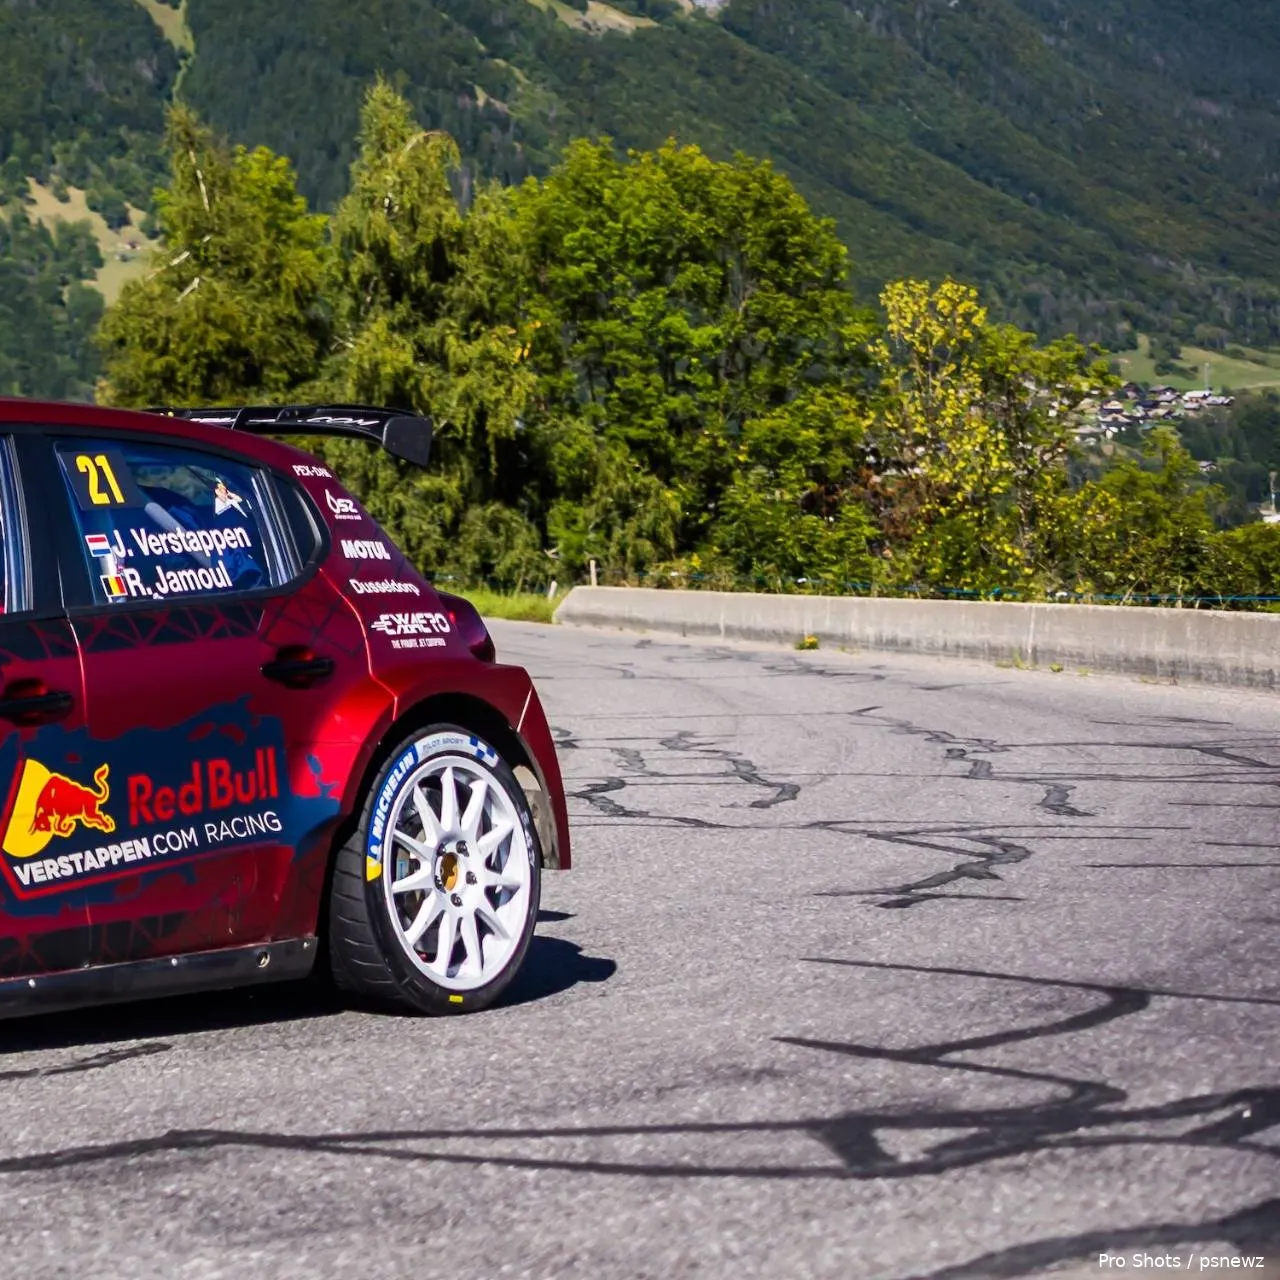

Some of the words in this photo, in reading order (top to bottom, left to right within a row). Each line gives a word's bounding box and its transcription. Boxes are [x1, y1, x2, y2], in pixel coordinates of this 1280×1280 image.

[75, 455, 125, 505] 21
[113, 530, 133, 558] J.
[131, 527, 252, 559] Verstappen
[341, 540, 391, 560] MOTUL
[125, 568, 152, 597] R.
[154, 560, 233, 595] Jamoul
[128, 761, 202, 827] Red
[208, 747, 278, 810] Bull
[372, 750, 415, 839] MICHELIN
[13, 827, 199, 886] VERSTAPPEN.COM
[207, 810, 283, 844] RACING
